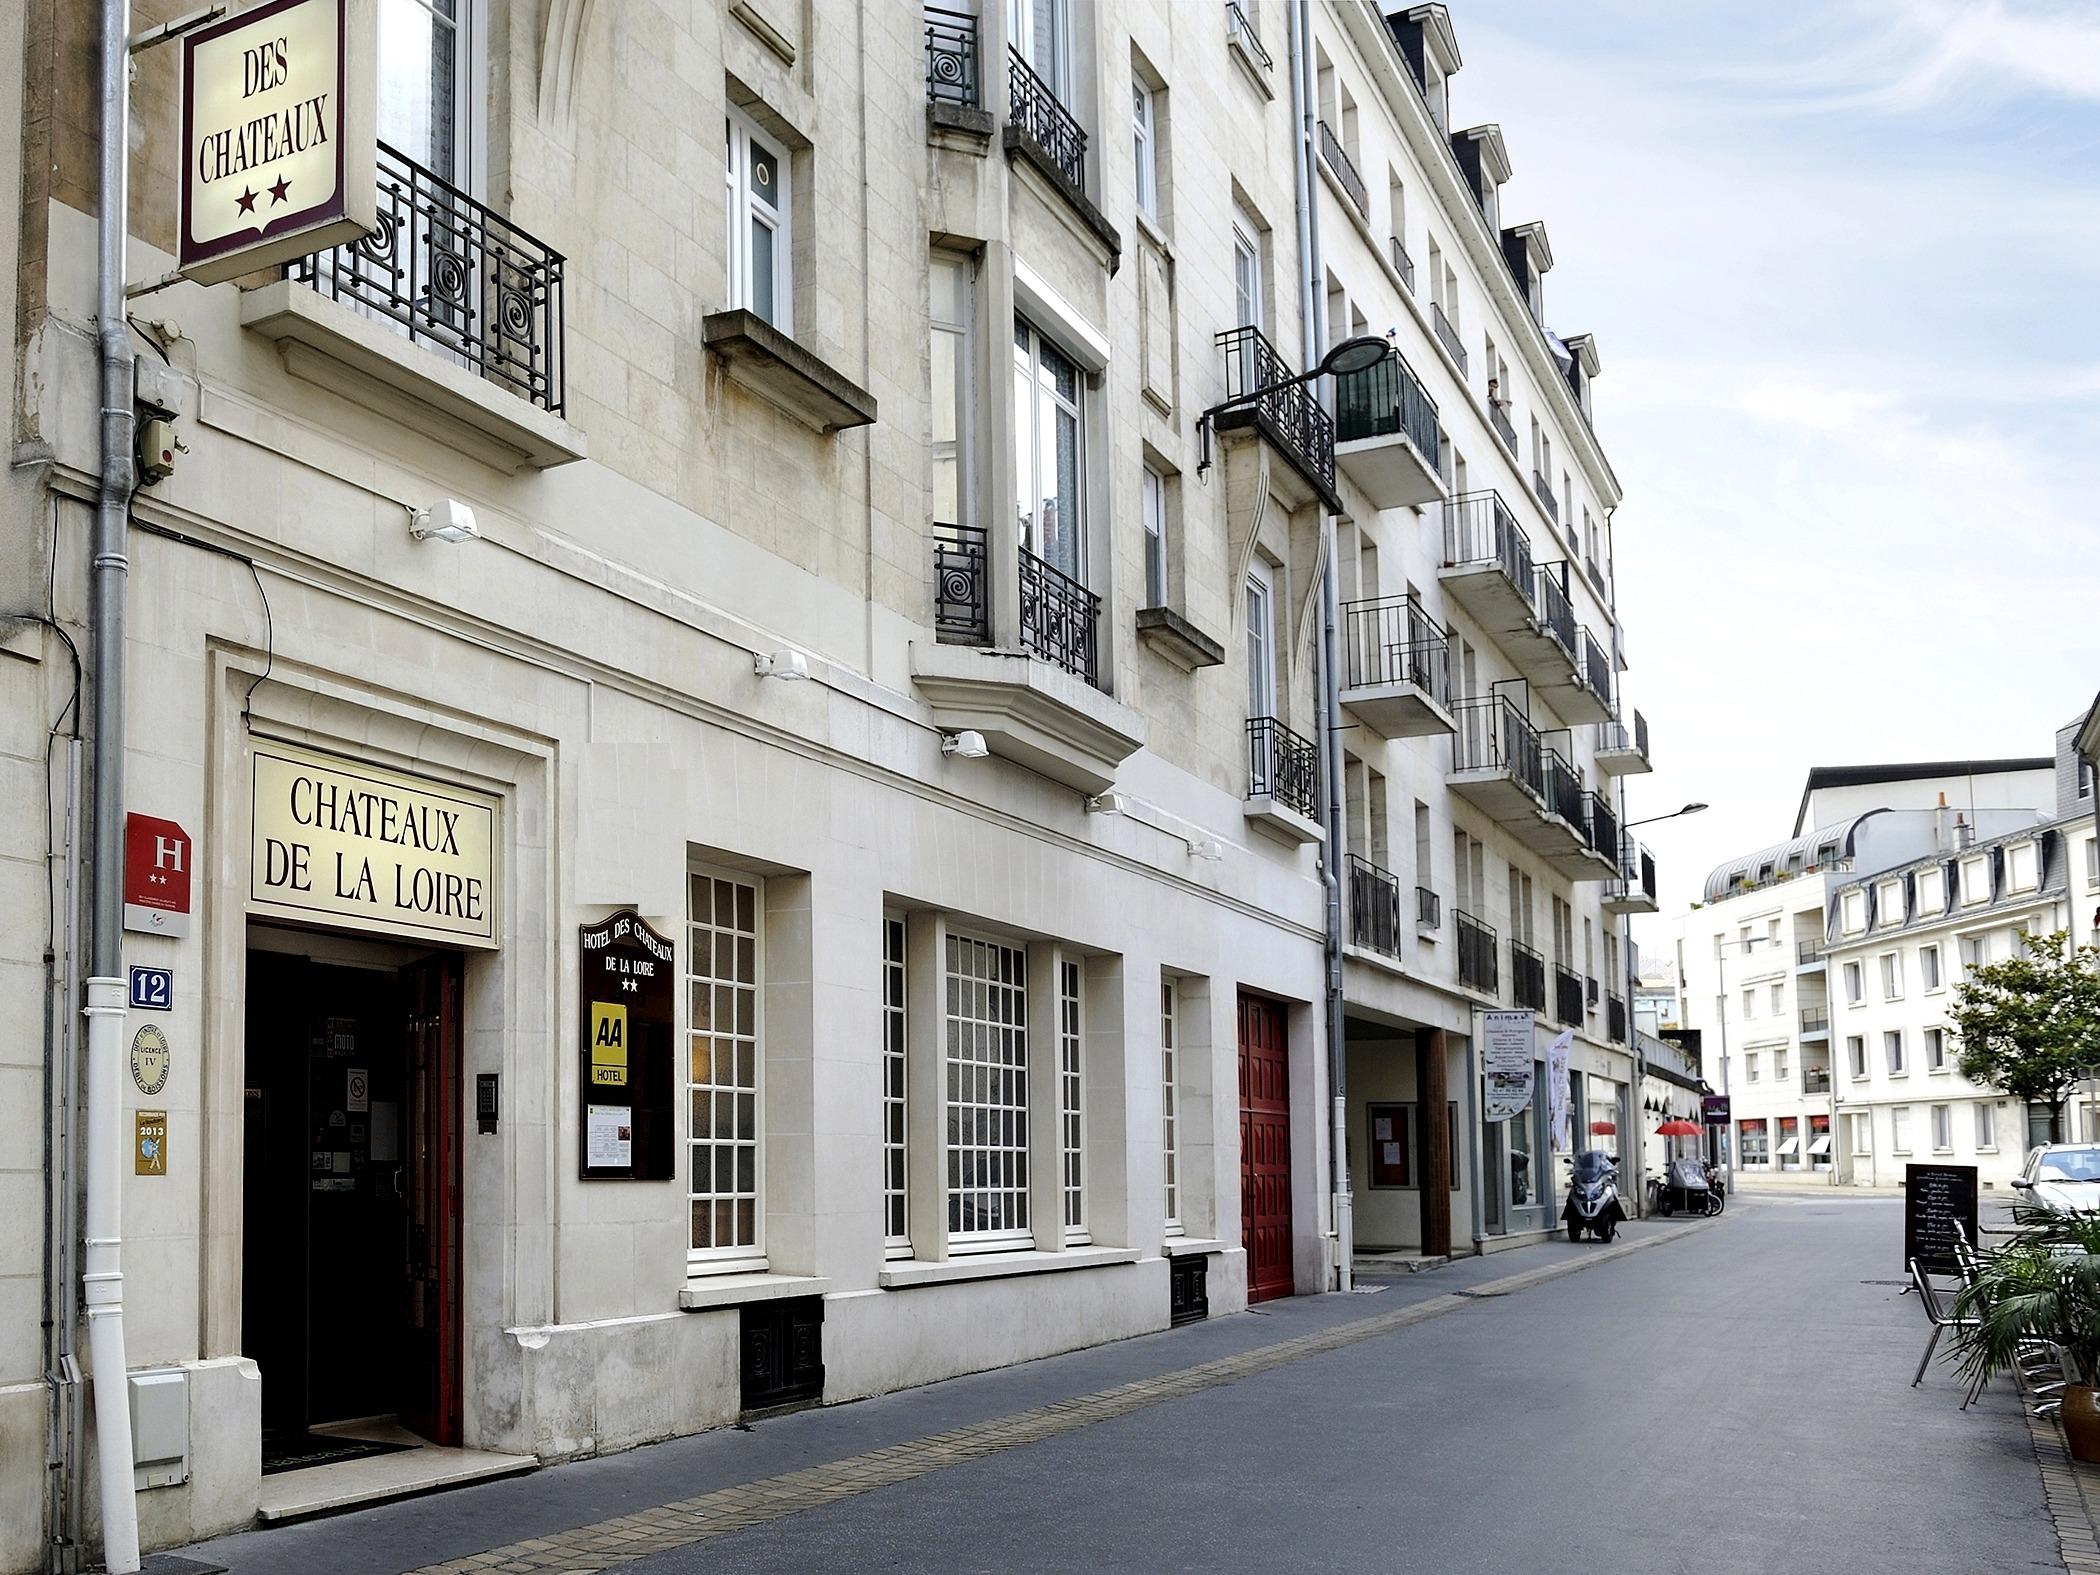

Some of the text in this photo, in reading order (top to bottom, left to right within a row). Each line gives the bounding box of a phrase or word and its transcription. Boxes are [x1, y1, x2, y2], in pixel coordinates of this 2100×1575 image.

[242, 36, 287, 98] DES
[199, 94, 328, 184] CHATEAUX
[290, 776, 460, 856] CHATEAUX
[154, 835, 184, 872] H
[265, 838, 483, 921] DE LA LOIRE
[584, 918, 673, 962] HOTEL DES CHATEAUX
[605, 956, 655, 976] DE LA LOIRE
[138, 973, 166, 1003] 12
[595, 1017, 622, 1047] AA
[145, 1057, 156, 1066] IV
[597, 1070, 622, 1082] HOTEL
[140, 1126, 164, 1136] 2013
